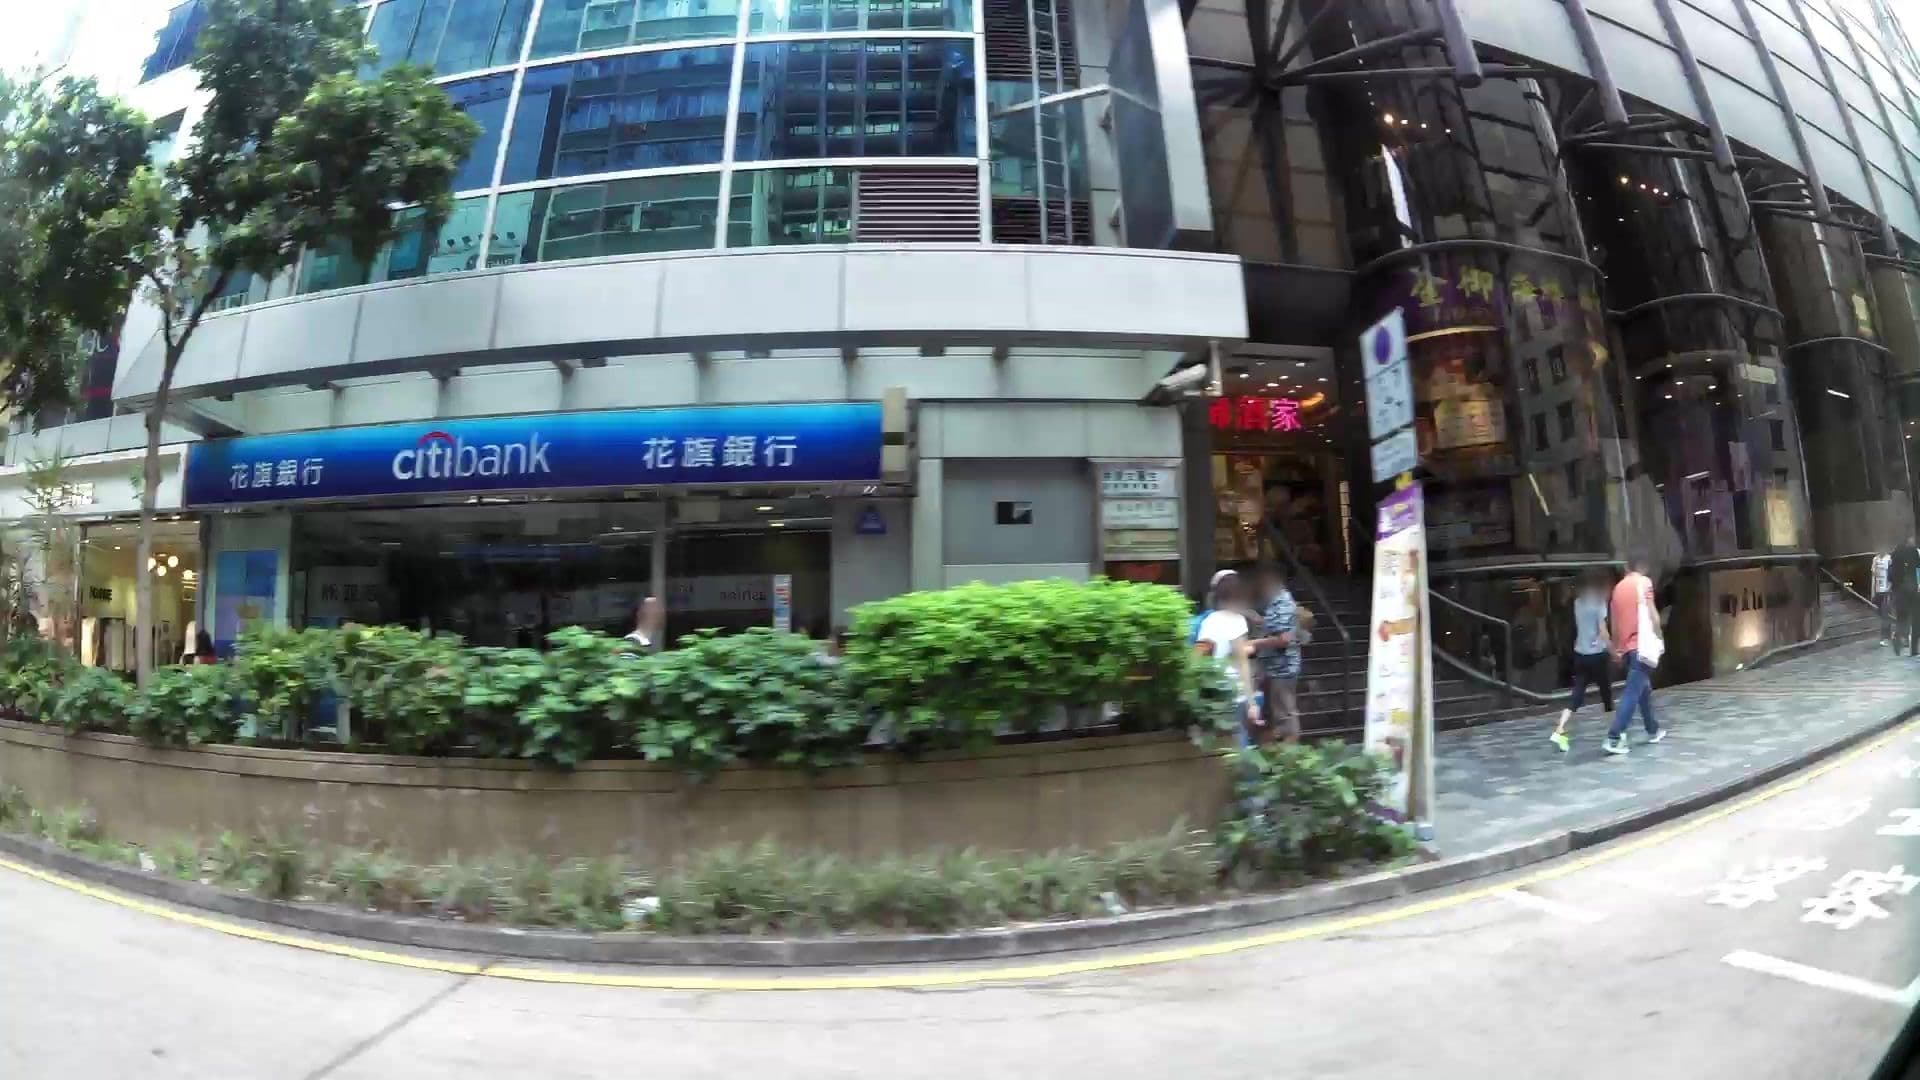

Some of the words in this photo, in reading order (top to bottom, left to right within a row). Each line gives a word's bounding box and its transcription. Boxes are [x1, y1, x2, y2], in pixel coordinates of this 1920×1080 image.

[392, 432, 551, 480] citibank
[642, 435, 798, 469] 花旗銀行
[229, 457, 324, 490] 花旗銀行
